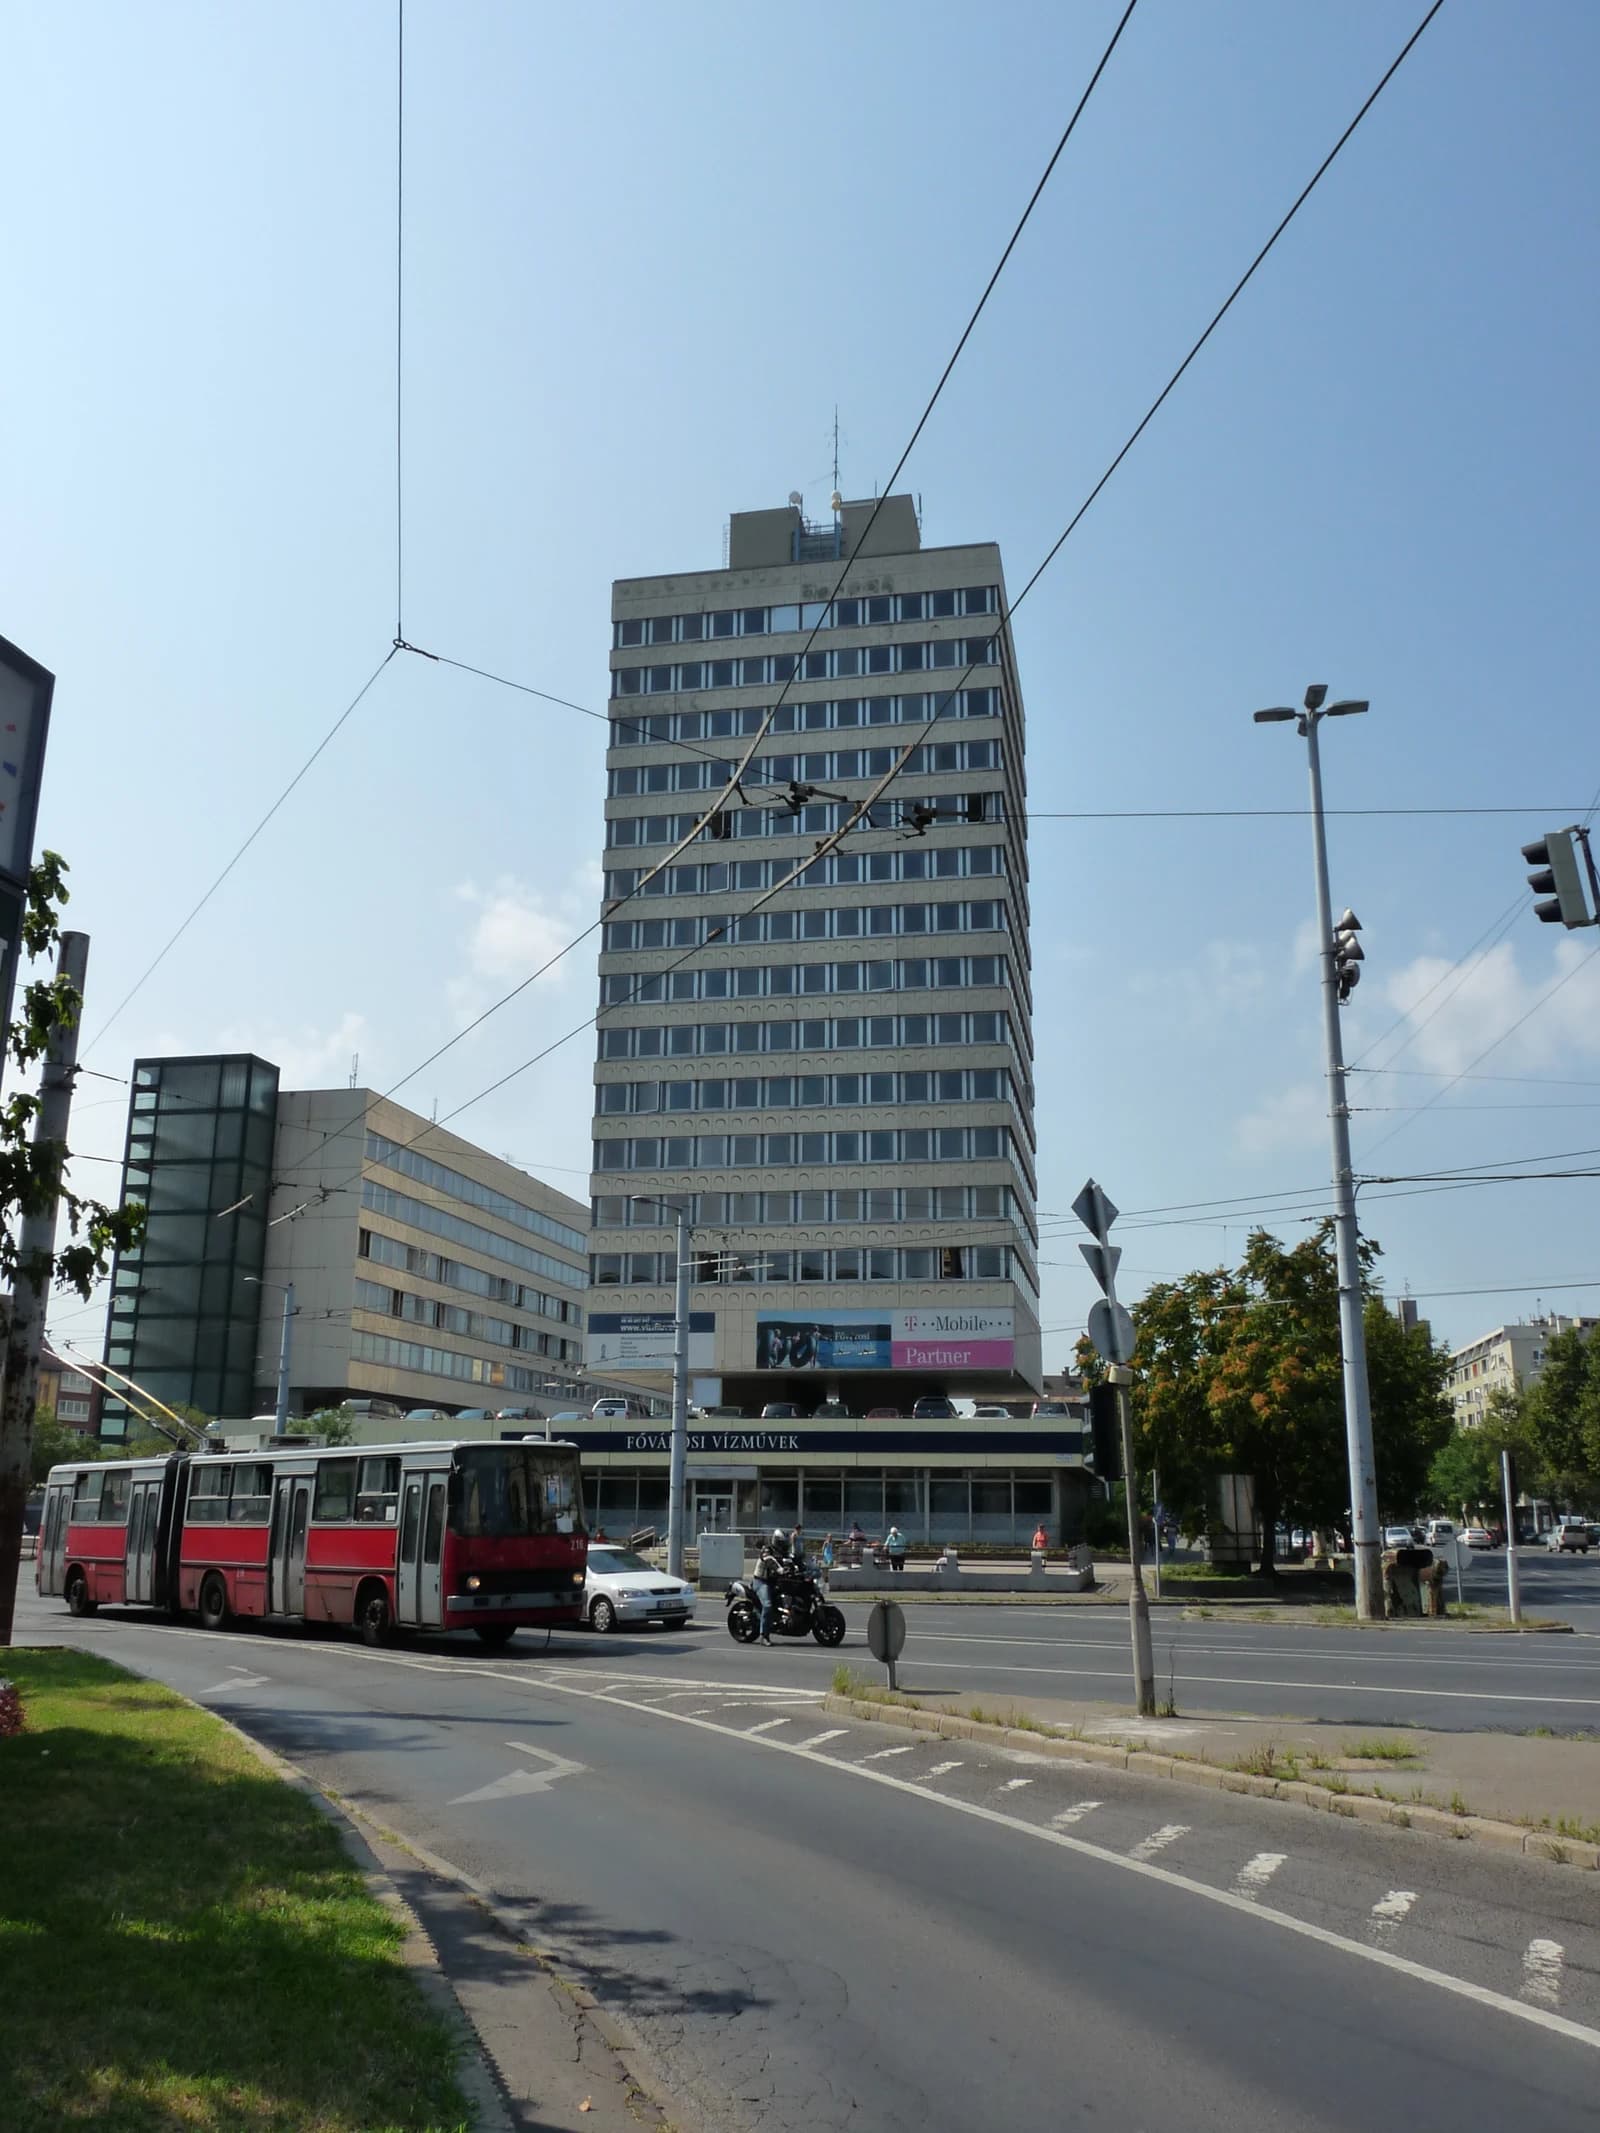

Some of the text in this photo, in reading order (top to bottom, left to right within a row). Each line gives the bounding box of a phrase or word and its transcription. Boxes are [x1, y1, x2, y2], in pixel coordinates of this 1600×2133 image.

[936, 1315, 988, 1331] Mobile
[906, 1347, 971, 1364] Partner
[626, 1432, 799, 1449] FŐVÁSI VÍZMŰVEK
